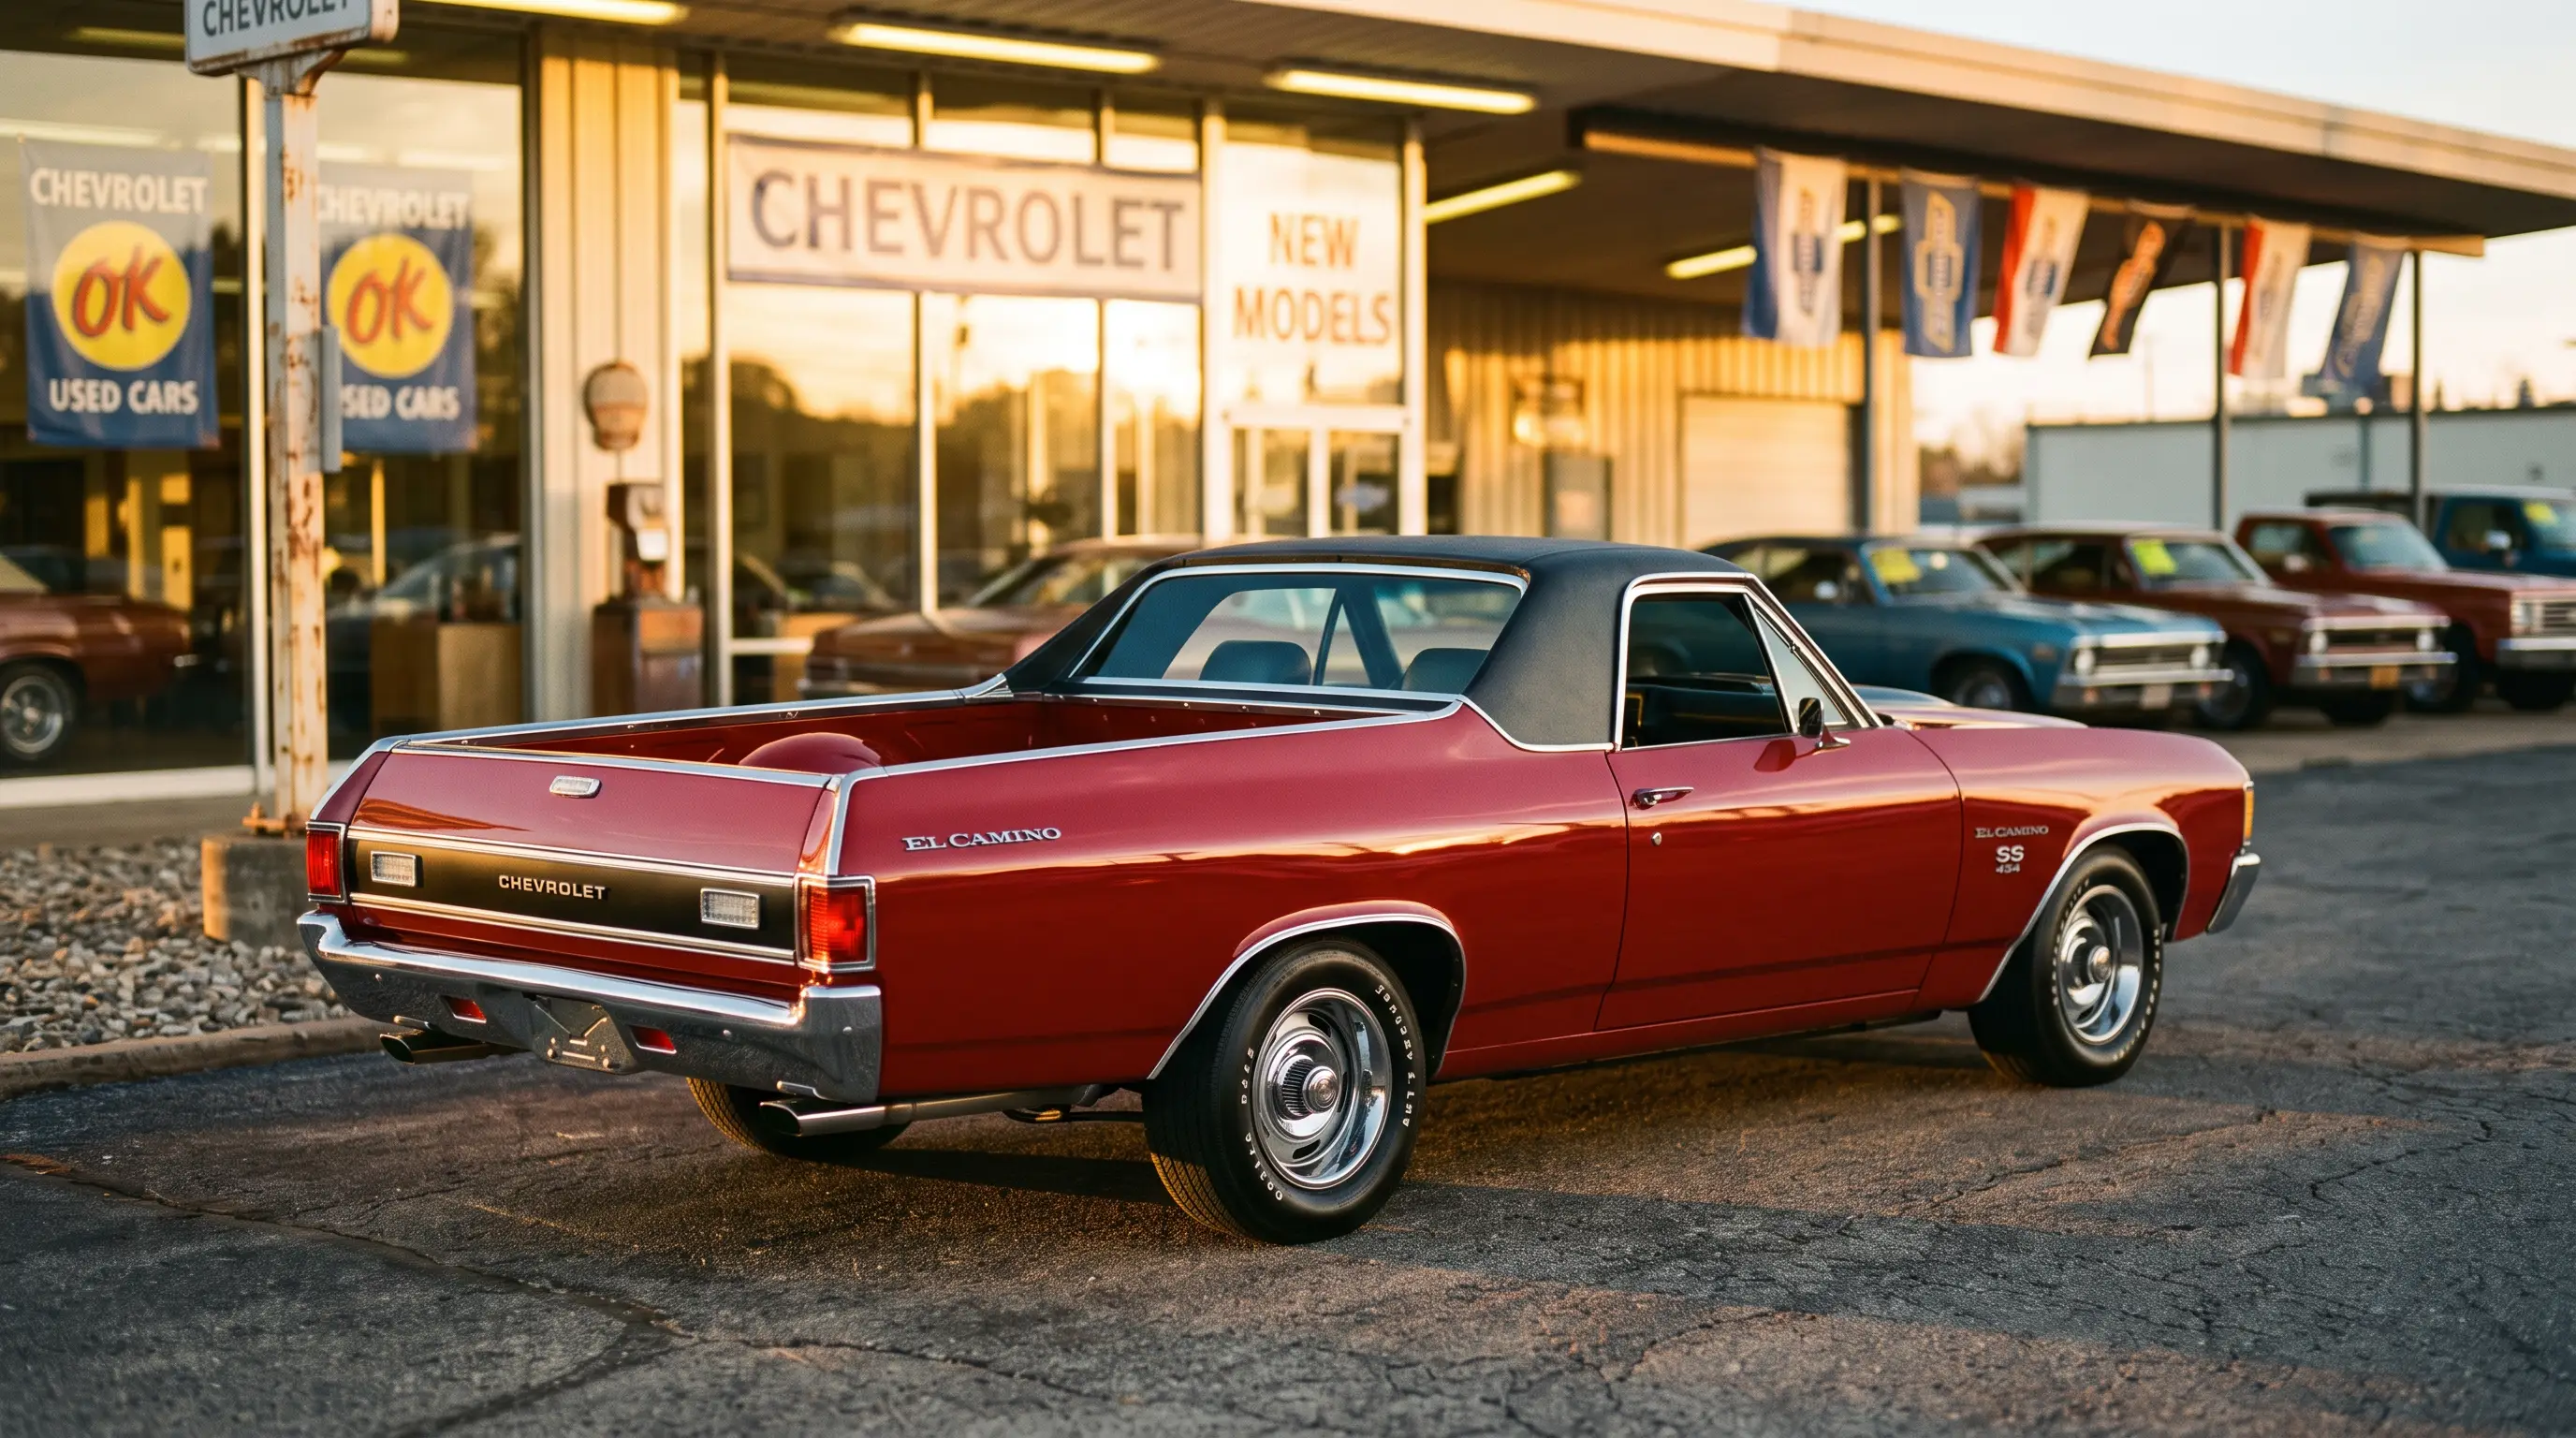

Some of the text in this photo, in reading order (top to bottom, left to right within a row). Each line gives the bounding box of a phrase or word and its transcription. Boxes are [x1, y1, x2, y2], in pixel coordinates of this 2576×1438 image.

[30, 168, 208, 213] CHEVROLET
[751, 169, 1185, 271] CHEVROLET
[1269, 213, 1359, 269] NEW
[72, 245, 170, 338] OK
[345, 255, 433, 345] OK
[1234, 286, 1391, 345] MODELS
[49, 378, 199, 415] USED CARS
[342, 385, 461, 420] SED CARS
[902, 827, 1061, 851] EL CAMINO
[1995, 825, 2049, 838] CAMINO
[1996, 844, 2025, 863] SS
[1996, 862, 2021, 873] 454
[499, 874, 606, 900] CHEVROLET
